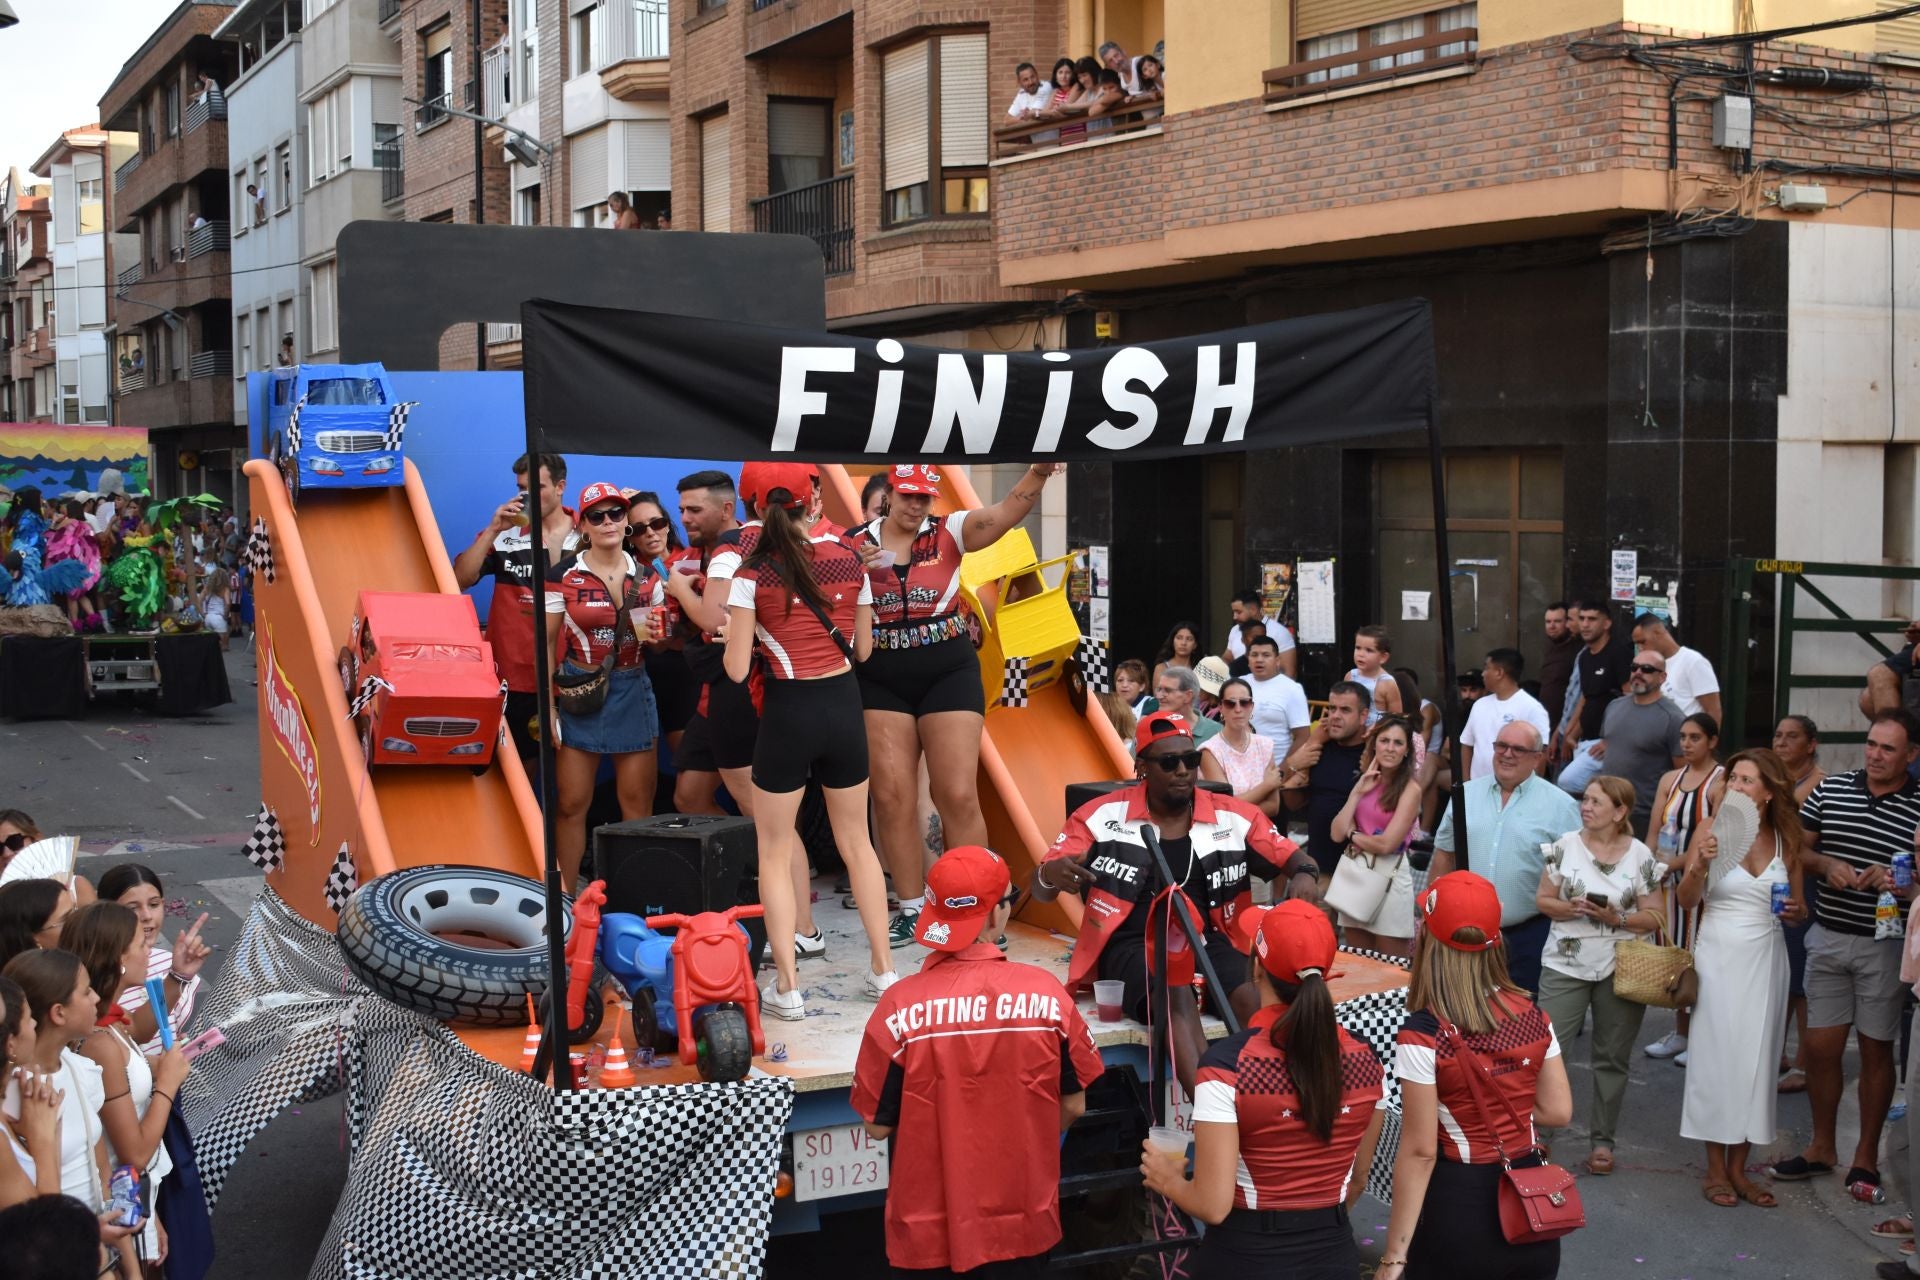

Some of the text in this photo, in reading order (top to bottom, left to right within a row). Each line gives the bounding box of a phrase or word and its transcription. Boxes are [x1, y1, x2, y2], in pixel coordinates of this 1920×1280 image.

[374, 864, 446, 923] PERFORMANCE
[924, 931, 948, 944] RACING
[885, 993, 1062, 1042] EXCITING GAME
[805, 1127, 877, 1158] SO VE
[810, 1160, 878, 1192] 19123
